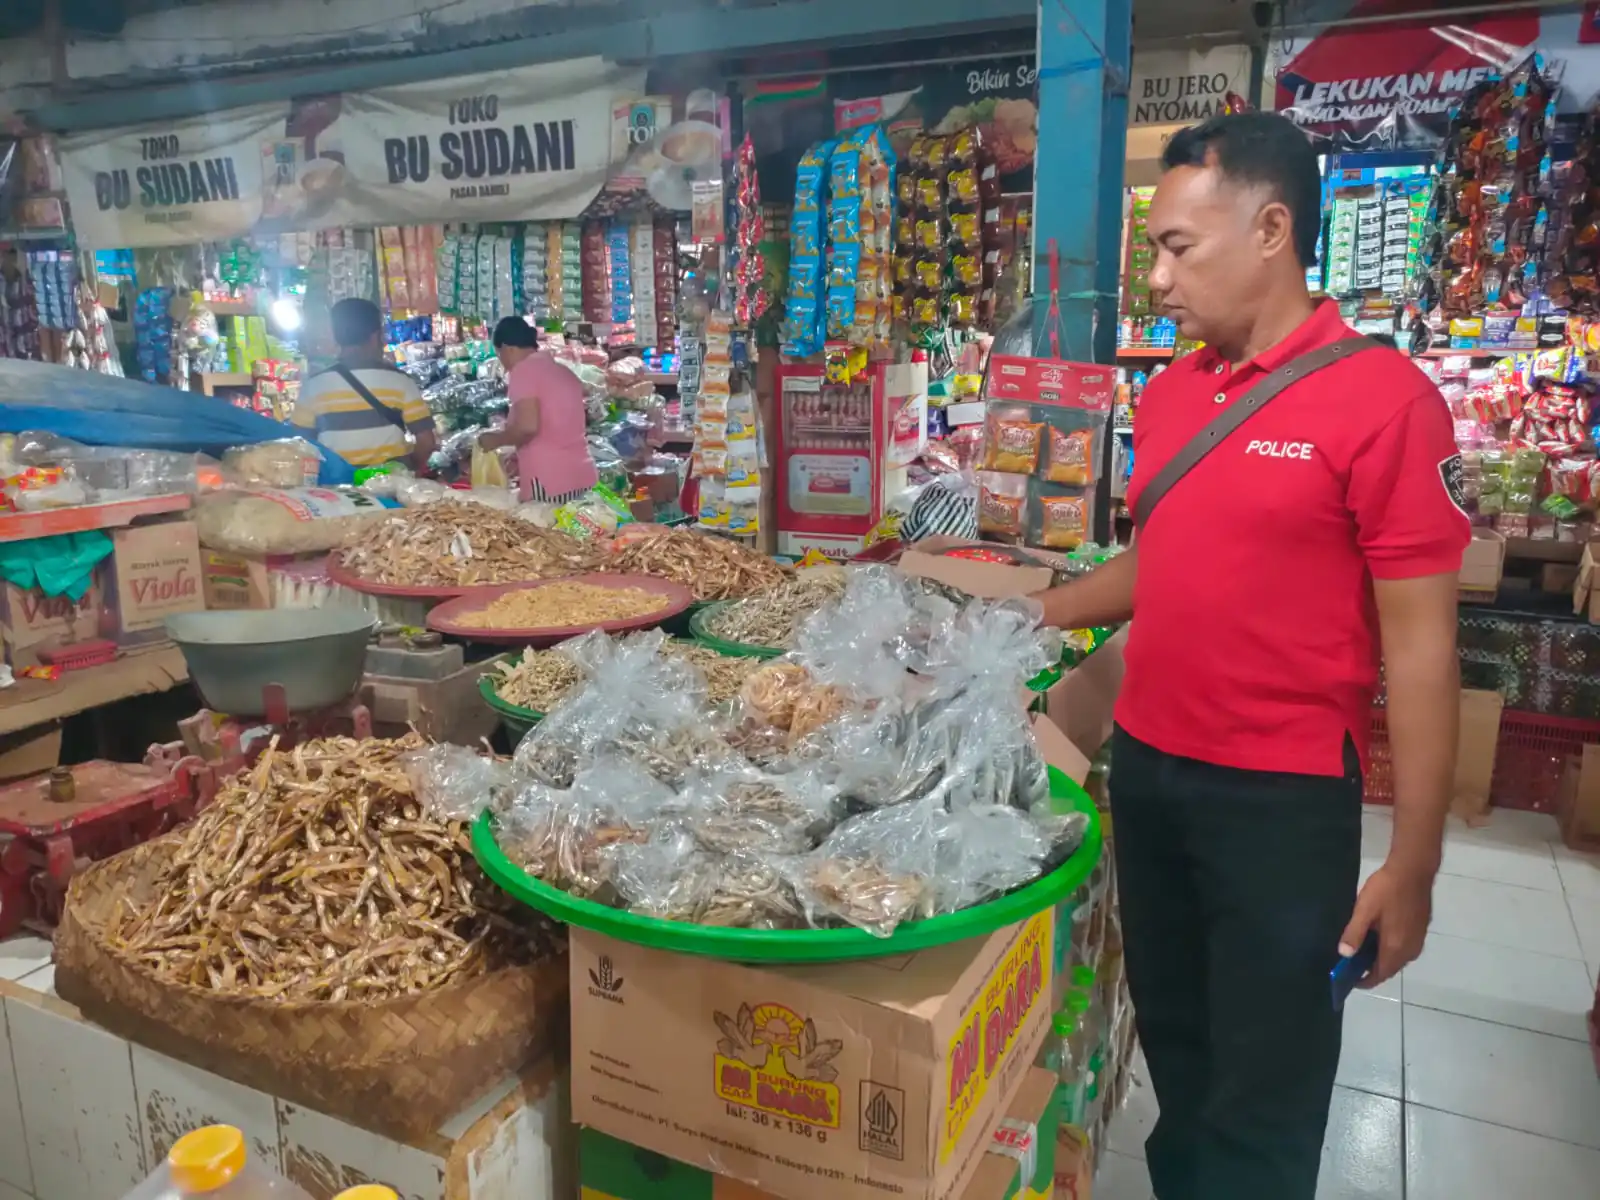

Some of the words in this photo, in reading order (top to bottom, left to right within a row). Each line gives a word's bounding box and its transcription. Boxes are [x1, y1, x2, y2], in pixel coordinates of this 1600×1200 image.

[966, 68, 1010, 94] Bikin
[1016, 64, 1038, 87] Se
[1142, 78, 1170, 98] BU
[1175, 73, 1228, 101] JERO
[1293, 70, 1435, 106] LEKUKAN
[1438, 66, 1496, 93] ME
[448, 94, 499, 125] TOKO
[384, 135, 430, 184] BU
[439, 120, 576, 180] SUDANI
[94, 168, 131, 211] BU
[136, 156, 239, 208] SUDANI
[1245, 440, 1315, 460] POLICE
[800, 545, 851, 558] Ykult
[129, 567, 198, 604] Viola
[950, 1011, 981, 1111] MI
[984, 942, 1042, 1080] DARA
[756, 1071, 828, 1100] BURUNG
[726, 1103, 747, 1120] Isi:
[773, 1119, 782, 1129] x
[787, 1121, 813, 1139] 136
[817, 1130, 828, 1144] g
[947, 1074, 981, 1141] CAP
[863, 1130, 899, 1147] HALAL
